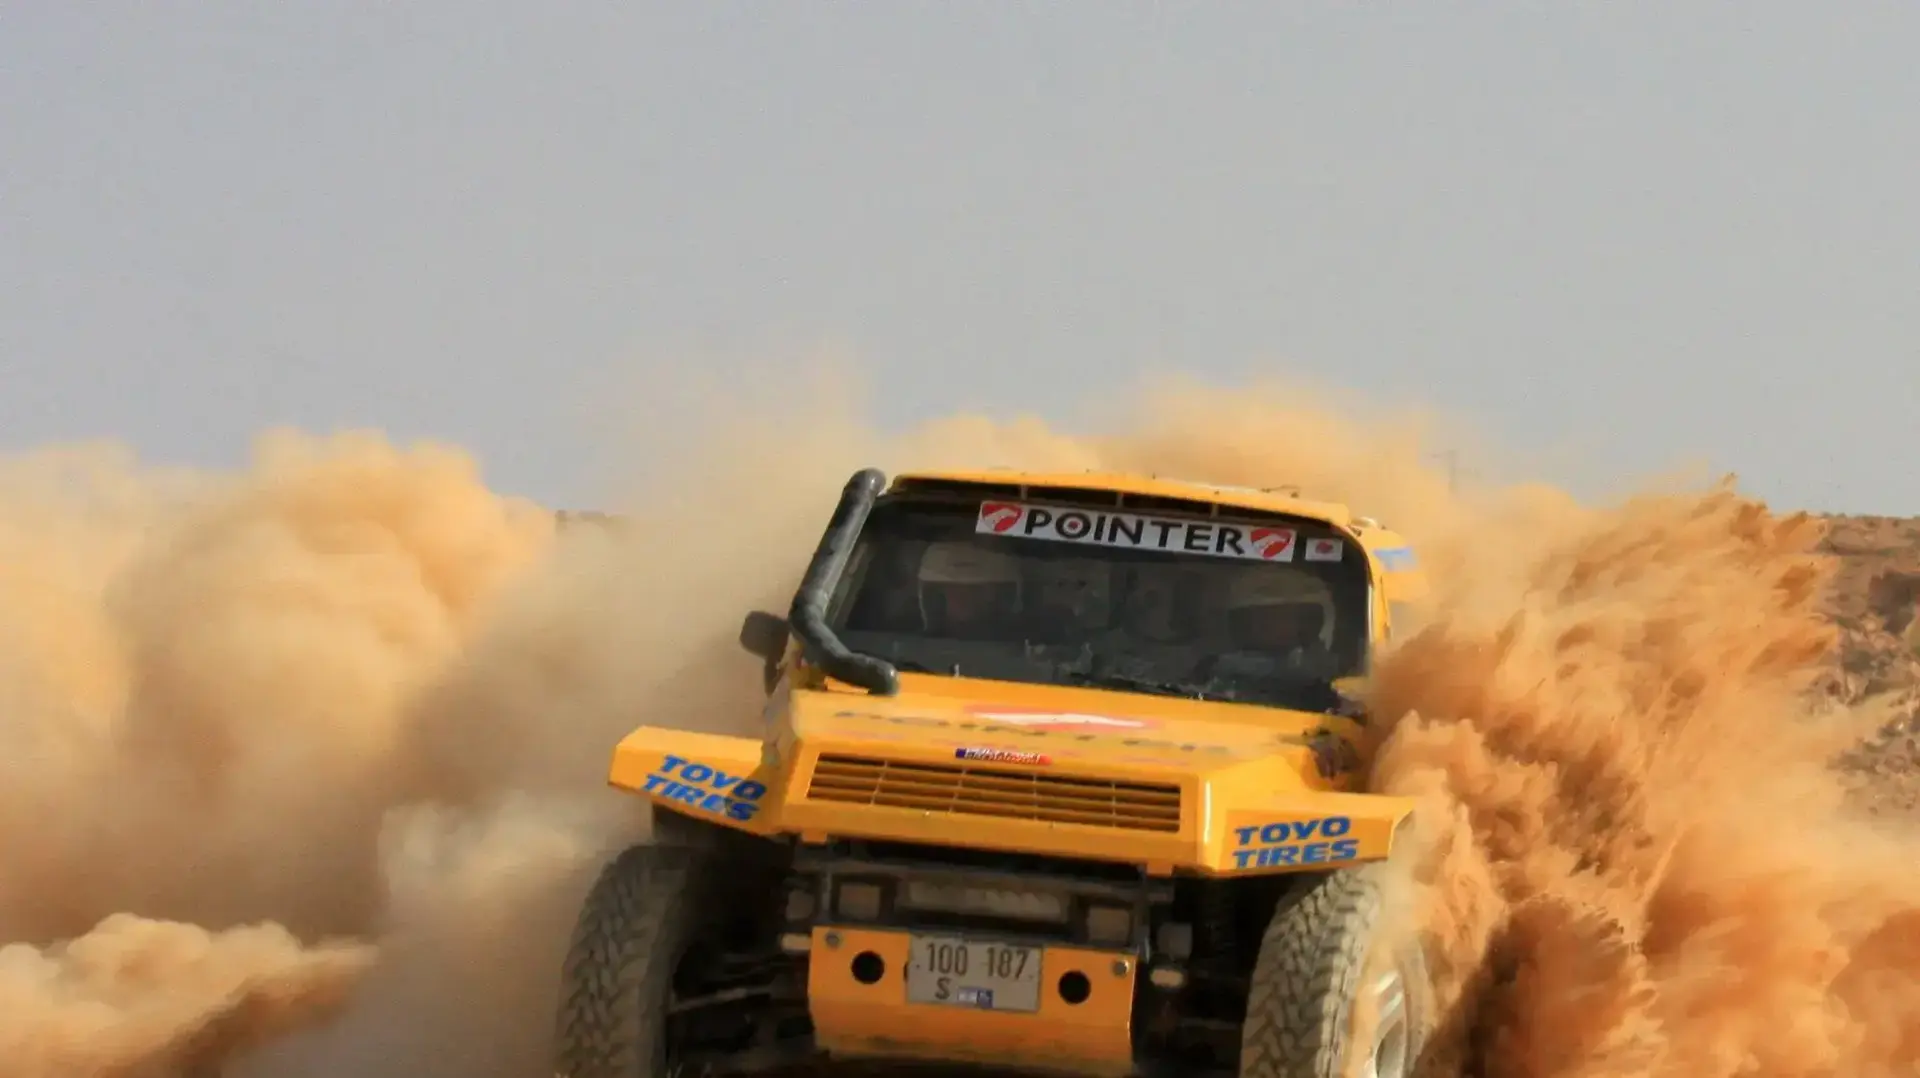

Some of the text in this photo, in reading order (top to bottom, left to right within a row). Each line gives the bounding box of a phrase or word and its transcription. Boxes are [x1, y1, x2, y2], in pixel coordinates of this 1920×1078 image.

[1023, 509, 1245, 555] POINTER
[661, 754, 767, 800] TOYO
[643, 774, 760, 820] TIRES
[1234, 816, 1351, 845] TOYO
[1232, 840, 1360, 868] TIRES
[927, 943, 1030, 980] 100 187
[935, 977, 951, 999] S
